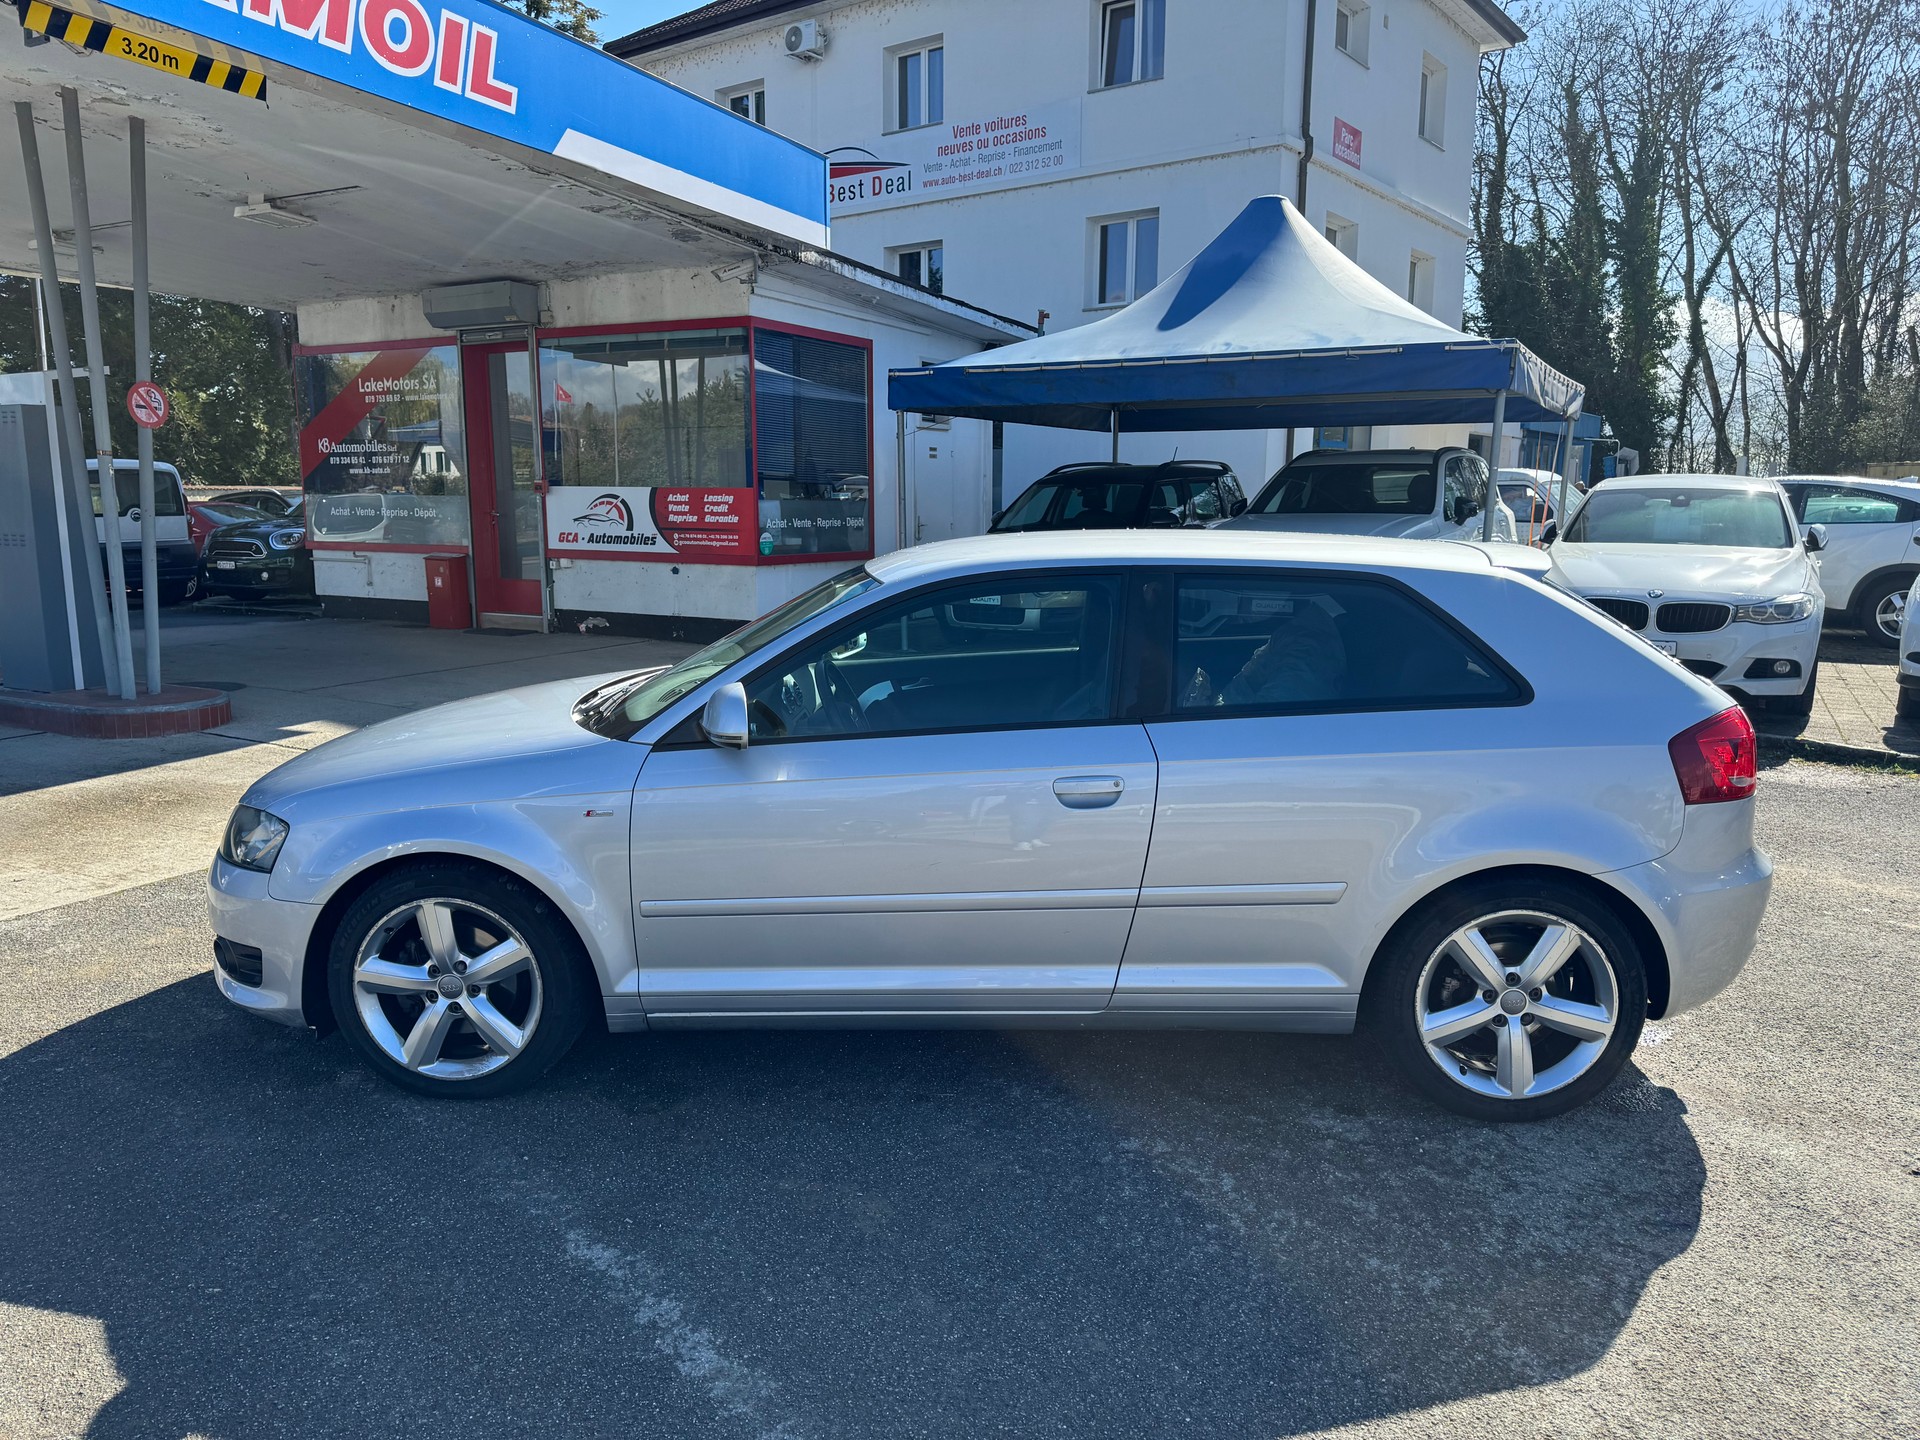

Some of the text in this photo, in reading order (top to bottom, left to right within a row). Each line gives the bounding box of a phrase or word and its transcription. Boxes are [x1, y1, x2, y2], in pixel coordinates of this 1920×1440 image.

[122, 37, 179, 70] 3.20 m
[952, 114, 1028, 139] Vente voitures
[937, 125, 1047, 157] neuves ou occasions
[923, 162, 943, 174] Vente
[949, 158, 971, 170] Achat
[977, 151, 1006, 166] Reprise
[1013, 139, 1063, 158] Financement
[922, 166, 1003, 188] www.auto-best-deal.ch
[1008, 162, 1023, 174] 022
[1025, 160, 1040, 171] 312
[1041, 158, 1052, 169] 52
[1053, 154, 1064, 166] 00
[872, 170, 911, 197] Deal
[358, 375, 437, 393] LakeMotors SA
[667, 493, 689, 502] Achat
[703, 493, 734, 504] Leasing
[330, 506, 350, 516] Achat
[356, 507, 375, 516] Vente
[381, 507, 409, 519] Reprise
[414, 507, 437, 519] Dépôt
[668, 504, 690, 512] Vente
[668, 514, 698, 523] Reprise
[704, 514, 739, 523] Garantie
[766, 518, 788, 529] Achat
[792, 518, 812, 528] Vente
[817, 518, 841, 529] Reprise
[846, 516, 865, 528] Dépôt
[558, 532, 579, 544] GCA
[587, 532, 656, 546] Automobiles
